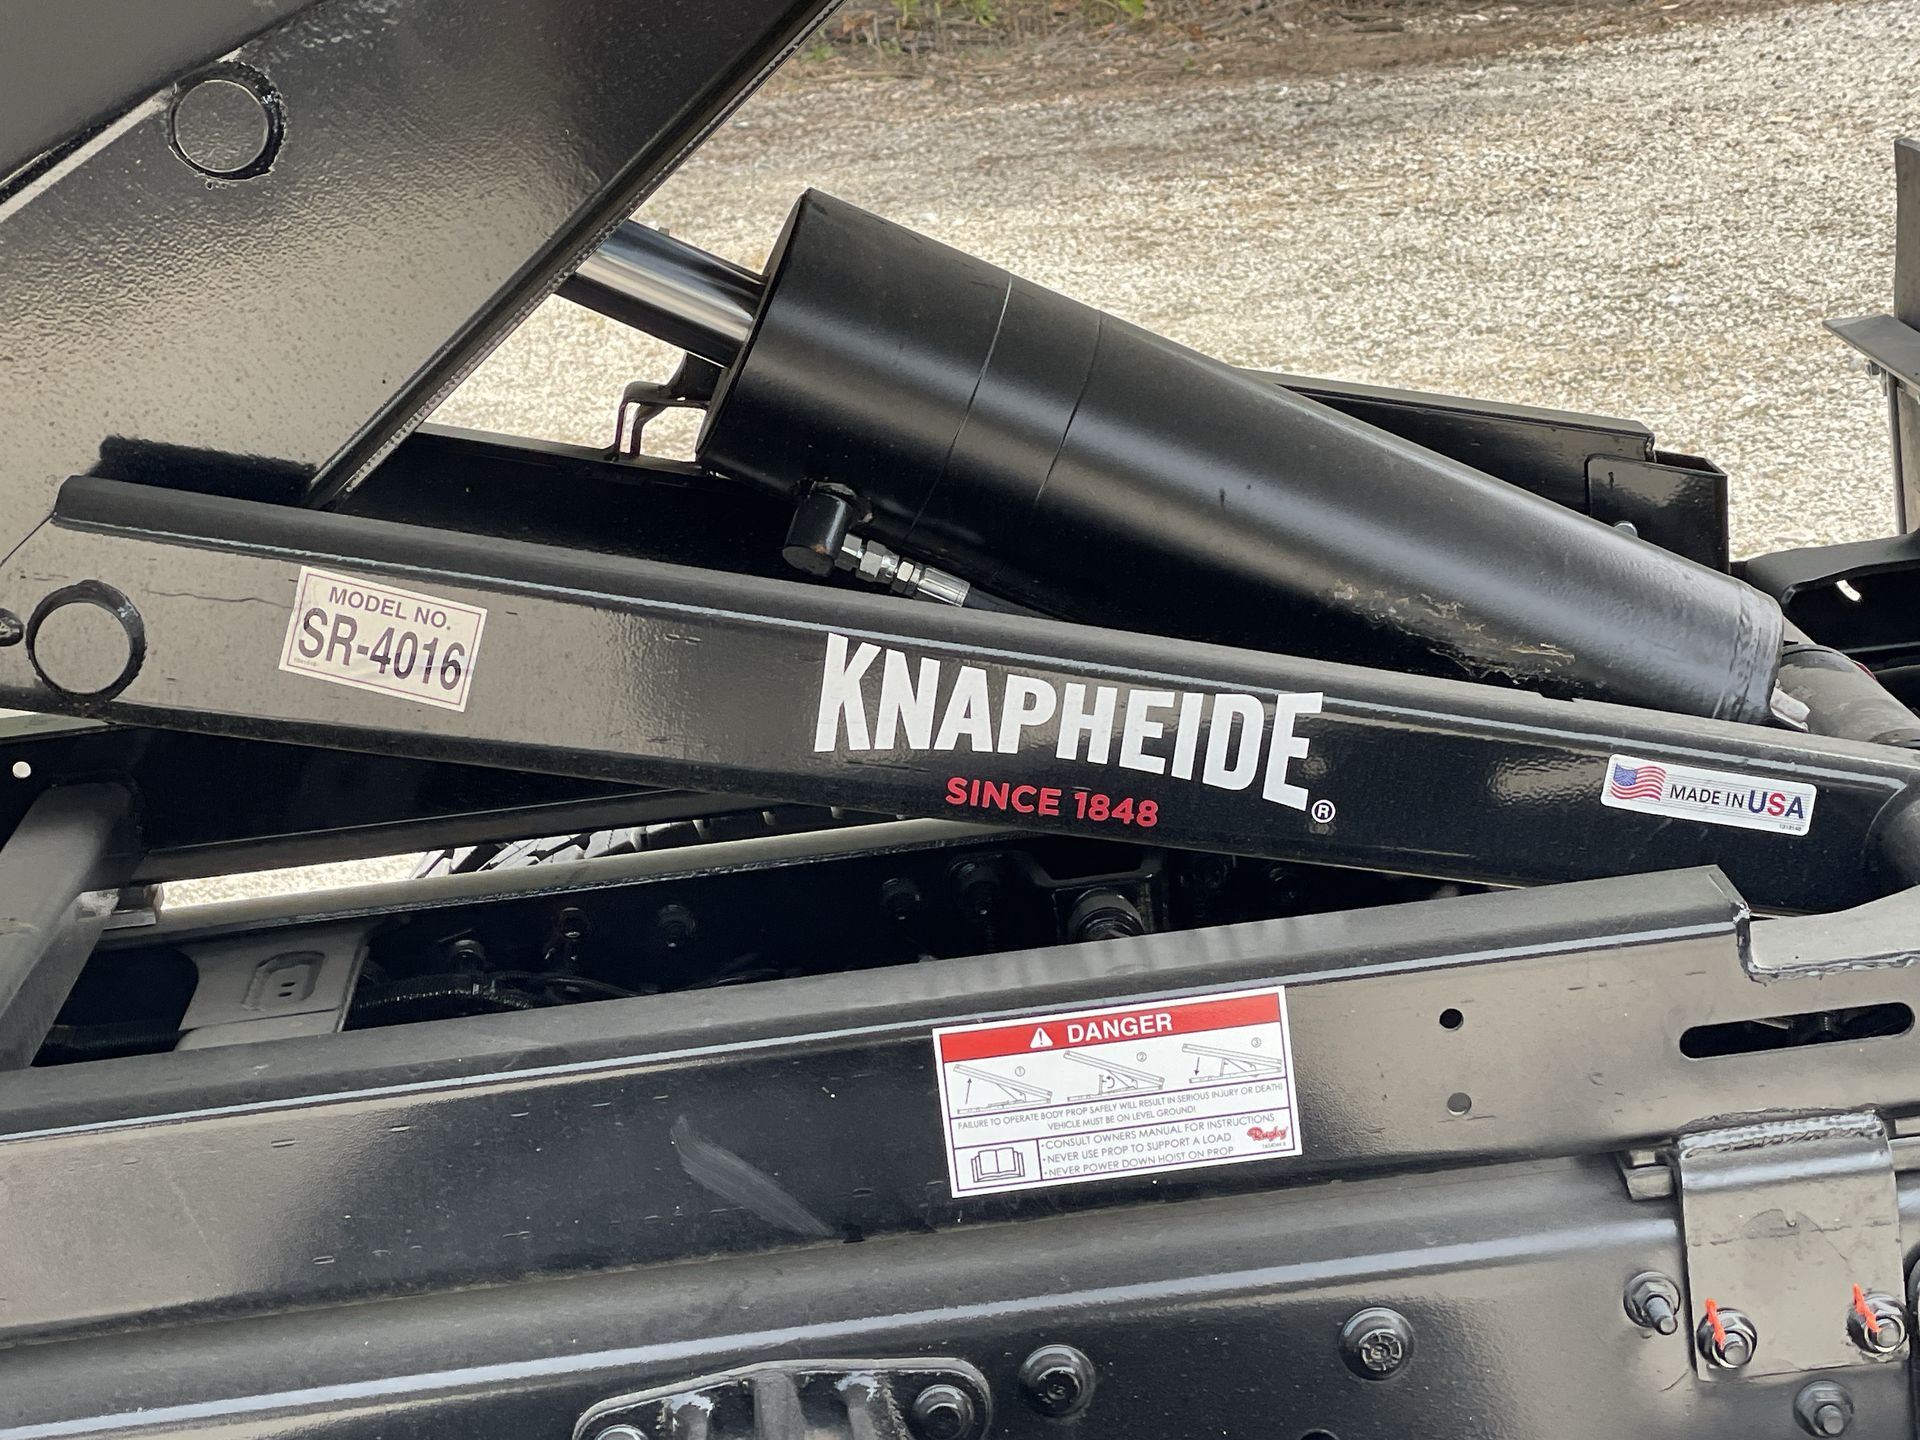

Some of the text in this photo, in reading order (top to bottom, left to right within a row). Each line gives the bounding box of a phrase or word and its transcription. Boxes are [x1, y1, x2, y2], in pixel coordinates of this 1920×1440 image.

[329, 586, 450, 630] MODEL NO.
[299, 608, 465, 690] SR-4016
[814, 633, 1323, 811] KNAPHEIDE
[945, 777, 1159, 828] SINCE 1848
[1670, 784, 1804, 819] MADE IN USA
[1067, 1013, 1173, 1043] DANGER
[957, 1118, 988, 1130] FAILURE
[990, 1117, 1001, 1126] TO
[1002, 1112, 1038, 1124] OPERATE
[1040, 1109, 1063, 1120] BODY
[1065, 1106, 1087, 1116] PROP
[1089, 1102, 1117, 1114] SAFELY
[1119, 1100, 1136, 1110] WILL
[1138, 1096, 1165, 1107] RESULT
[1167, 1095, 1175, 1104] IN
[1176, 1091, 1209, 1103] SERIOUS
[1211, 1087, 1238, 1098] INJURY
[1240, 1086, 1252, 1095] OR
[1047, 1119, 1080, 1130] VEHICLE
[1082, 1116, 1103, 1126] MUST
[1105, 1115, 1114, 1123] BE
[1116, 1113, 1130, 1122] ON
[1132, 1110, 1154, 1120] LEVEL
[1045, 1112, 1274, 1150] CONSULT OWNERS MANUAL FOR INSTRUCTIONS
[1047, 1132, 1231, 1163] NEVER USE PROP TO SUPPORT A LOAD
[1048, 1145, 1233, 1177] NEVER POWER DOWN HOIST ON PROP
